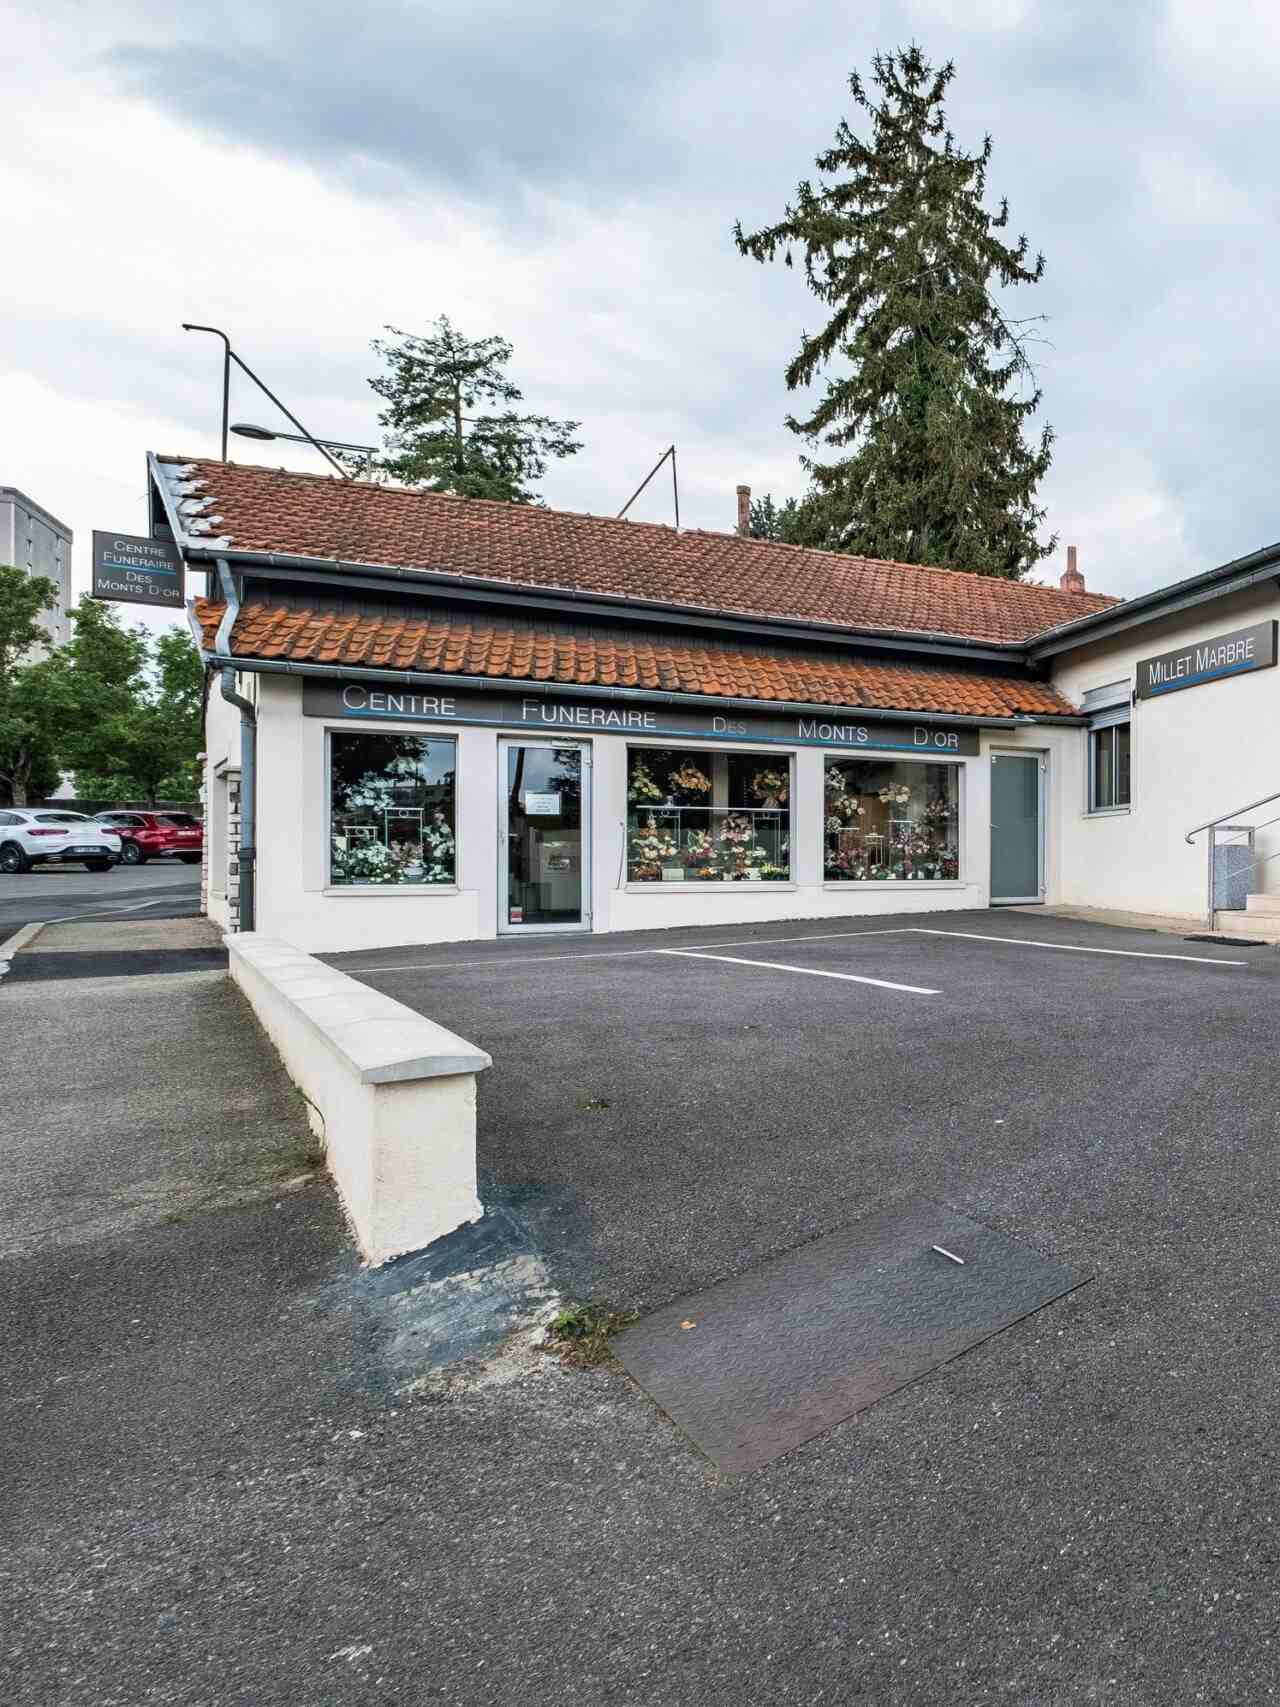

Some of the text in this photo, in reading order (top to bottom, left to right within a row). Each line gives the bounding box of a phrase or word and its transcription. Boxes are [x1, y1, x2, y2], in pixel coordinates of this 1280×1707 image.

[114, 541, 166, 557] CENTRE
[103, 551, 175, 569] FUNERAIRE
[97, 578, 143, 593] MONTS
[126, 571, 153, 584] DES
[1149, 638, 1255, 685] MILLET MARBRE
[342, 685, 456, 715] CENTRE
[521, 699, 656, 728] FUNERAIRE
[798, 719, 869, 742] MONTS
[913, 727, 960, 747] D'OR
